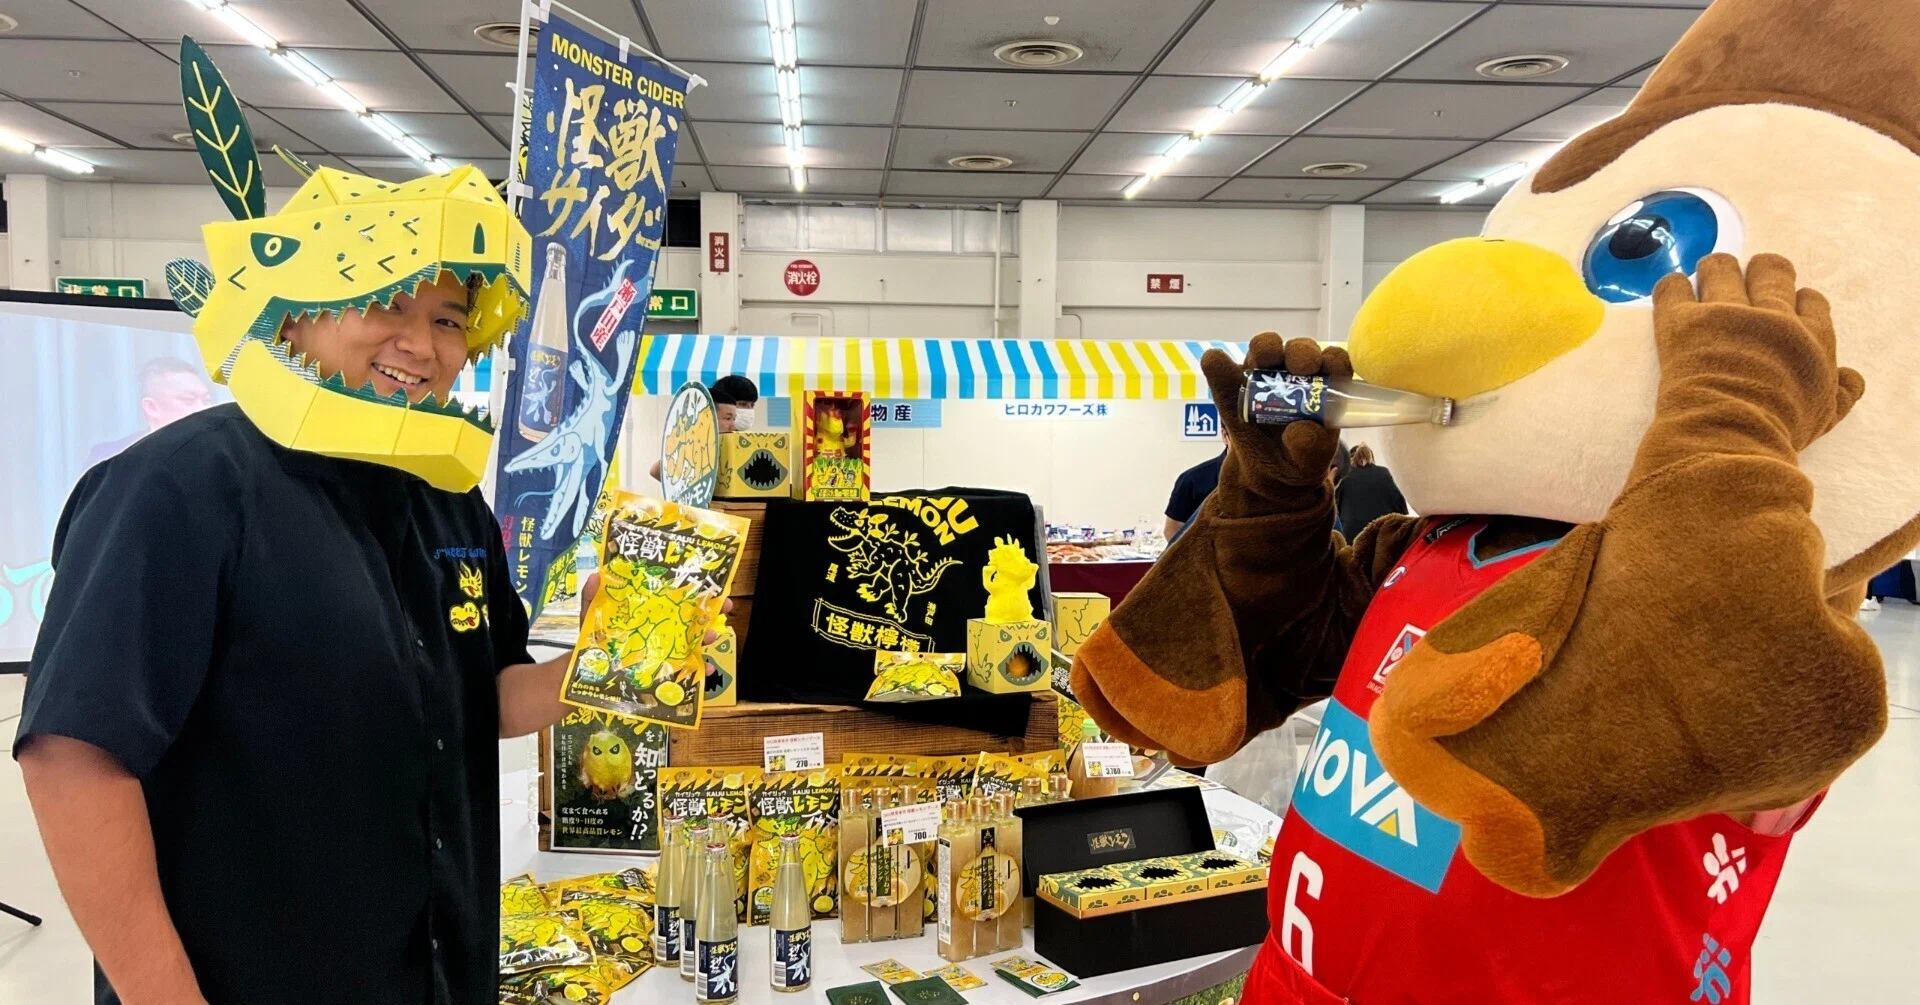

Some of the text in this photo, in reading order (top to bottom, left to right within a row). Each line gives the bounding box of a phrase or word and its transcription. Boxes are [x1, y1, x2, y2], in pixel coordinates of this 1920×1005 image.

[551, 32, 685, 109] MONSTER CIDER
[546, 77, 678, 198] 怪獣
[536, 168, 664, 260] サイダー
[714, 235, 725, 269] 消火器
[787, 270, 818, 285] 消火栓
[1150, 278, 1180, 290] 禁煙
[515, 516, 536, 594] 怪獣レモン
[696, 538, 727, 551] LEMON
[796, 759, 809, 768] 270
[792, 787, 833, 796] KAIJU LEMON
[1303, 726, 1419, 848] NOVA
[668, 797, 747, 816] 怪獣レモン
[757, 794, 835, 816] 怪獣レモン
[914, 831, 927, 840] 700
[1281, 850, 1324, 977] 6
